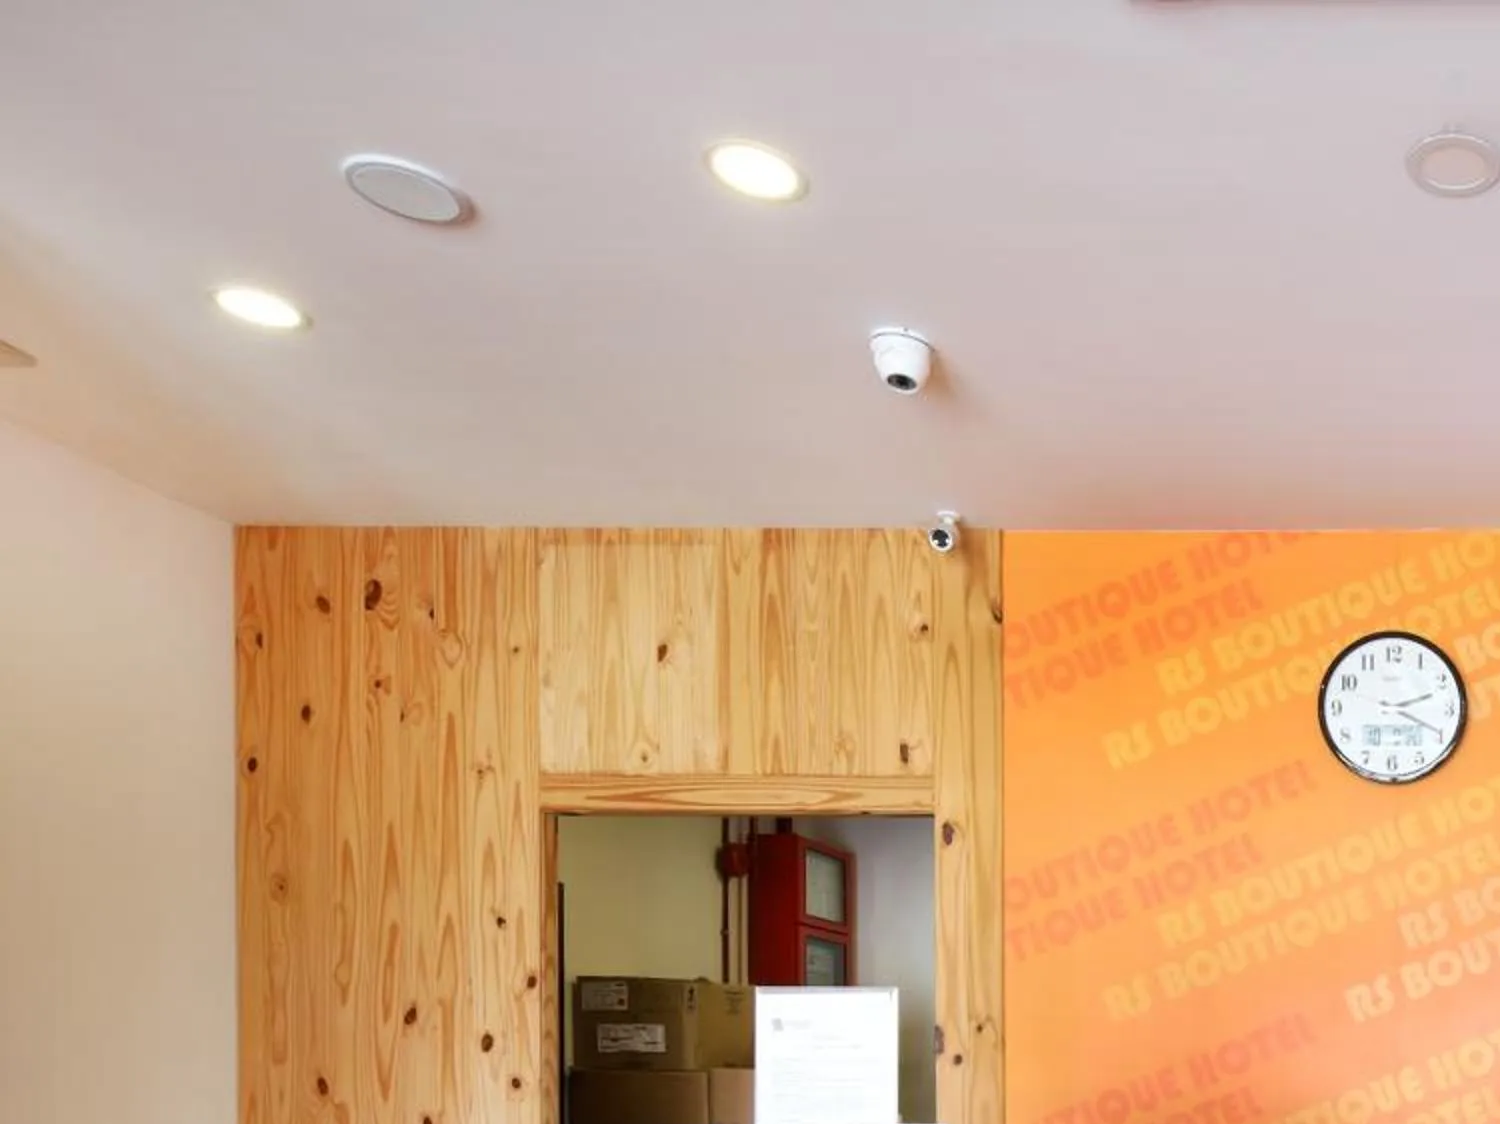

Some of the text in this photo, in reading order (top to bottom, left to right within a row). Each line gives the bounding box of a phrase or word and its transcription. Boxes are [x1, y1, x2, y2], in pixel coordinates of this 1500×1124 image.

[1133, 577, 1264, 655] HOTEL
[1154, 648, 1207, 697] RS
[1210, 561, 1427, 673] BOUTIQUE
[1362, 653, 1375, 671] 11
[1385, 645, 1402, 663] 12
[1418, 653, 1423, 670] 1
[1341, 674, 1357, 691] 10
[1436, 673, 1447, 690] 2
[1331, 701, 1342, 716] 9
[1444, 701, 1455, 717] 3
[1340, 727, 1351, 742] 8
[1102, 722, 1153, 770] RS
[1361, 751, 1370, 765] 7
[1387, 755, 1398, 771] 6
[1414, 751, 1424, 764] 5
[1187, 760, 1318, 836] HOTEL
[1133, 832, 1264, 911] HOTEL
[1154, 900, 1207, 950] RS
[1210, 813, 1427, 927] BOUTIQUE
[1397, 901, 1450, 949] RS
[1102, 973, 1152, 1022] RS
[1156, 885, 1372, 998] BOUTIQUE
[1344, 972, 1396, 1024] RS
[1187, 1011, 1318, 1088] HOTEL
